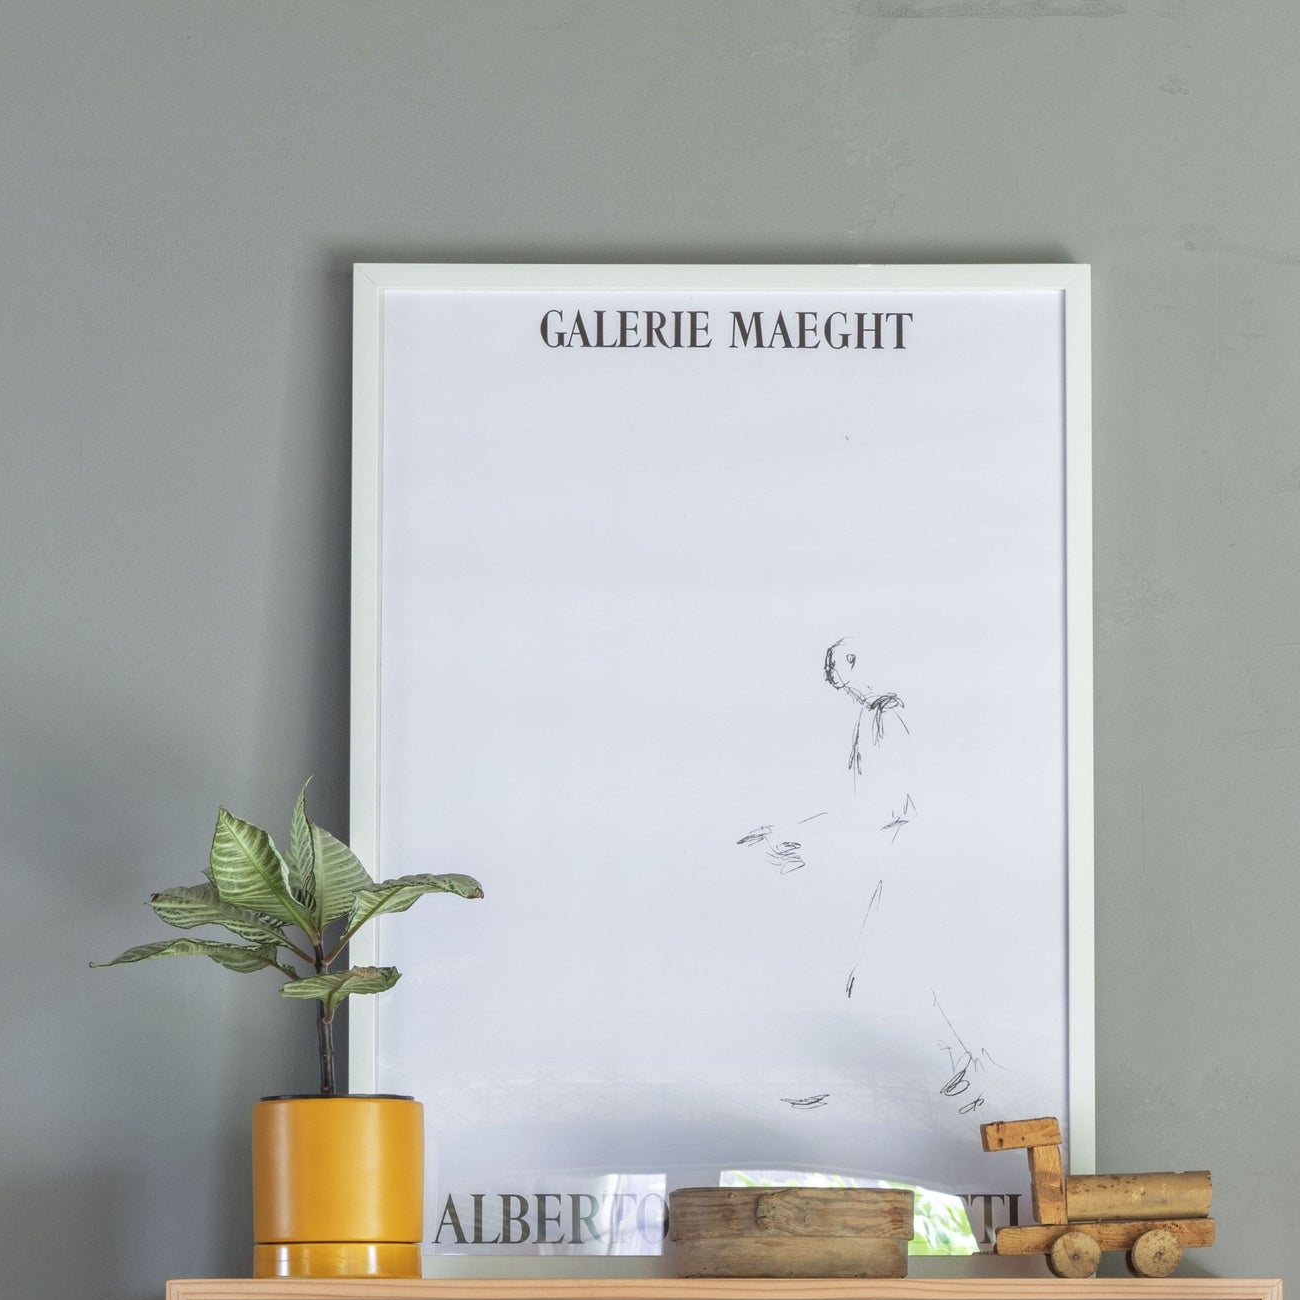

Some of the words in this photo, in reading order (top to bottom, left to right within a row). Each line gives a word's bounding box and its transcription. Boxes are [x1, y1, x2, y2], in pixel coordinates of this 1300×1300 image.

[540, 308, 713, 350] GALERIE
[728, 309, 914, 351] MAEGHT
[431, 1192, 670, 1245] ALBERTO
